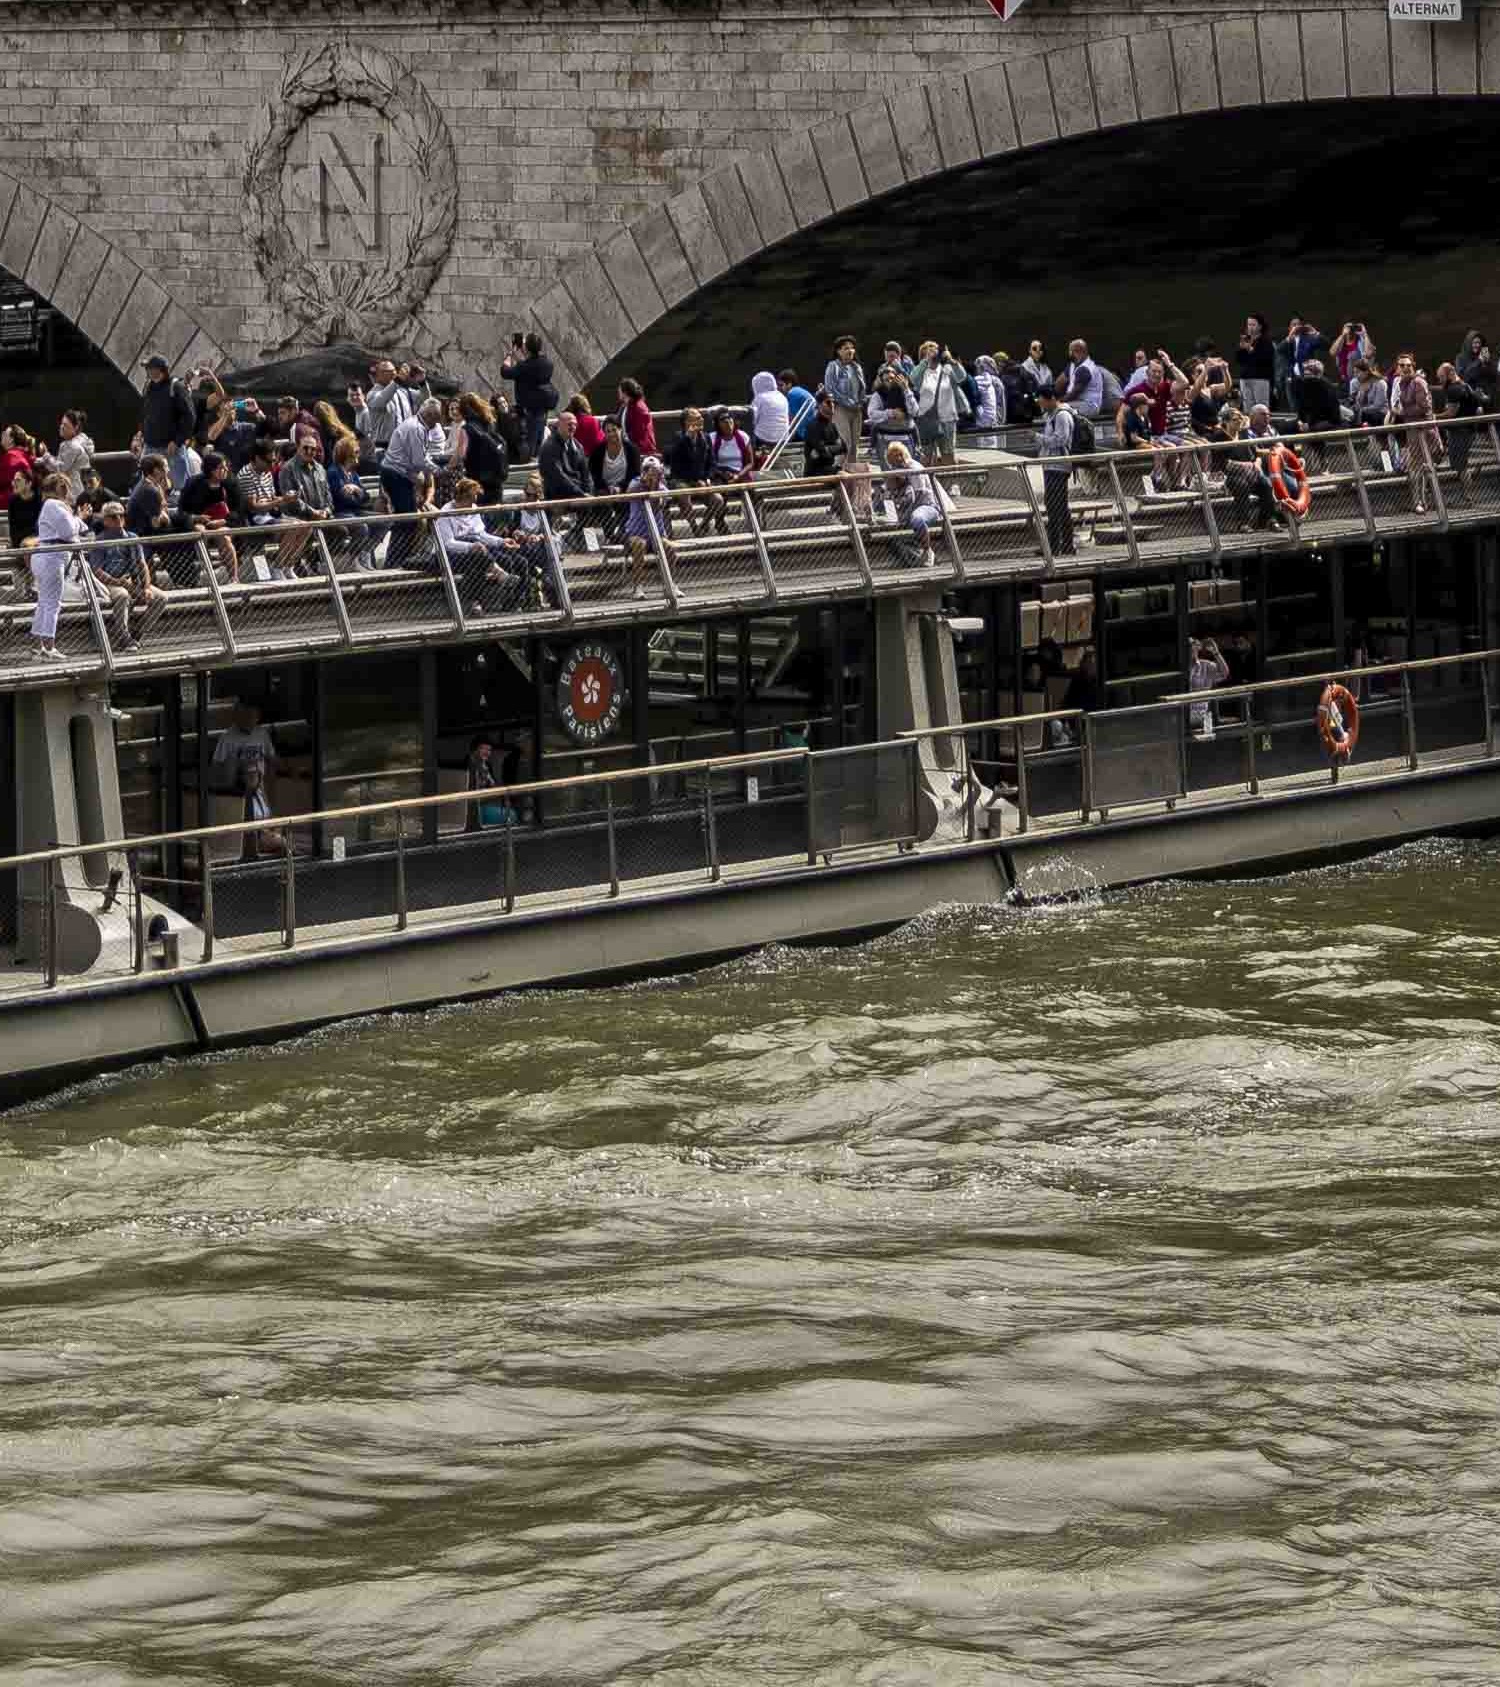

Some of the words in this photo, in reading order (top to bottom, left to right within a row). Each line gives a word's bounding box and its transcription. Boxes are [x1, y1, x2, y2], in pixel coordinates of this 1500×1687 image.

[1393, 2, 1457, 15] ALTERNAT
[560, 646, 617, 686] Bateaux
[563, 694, 621, 739] Parisiens
